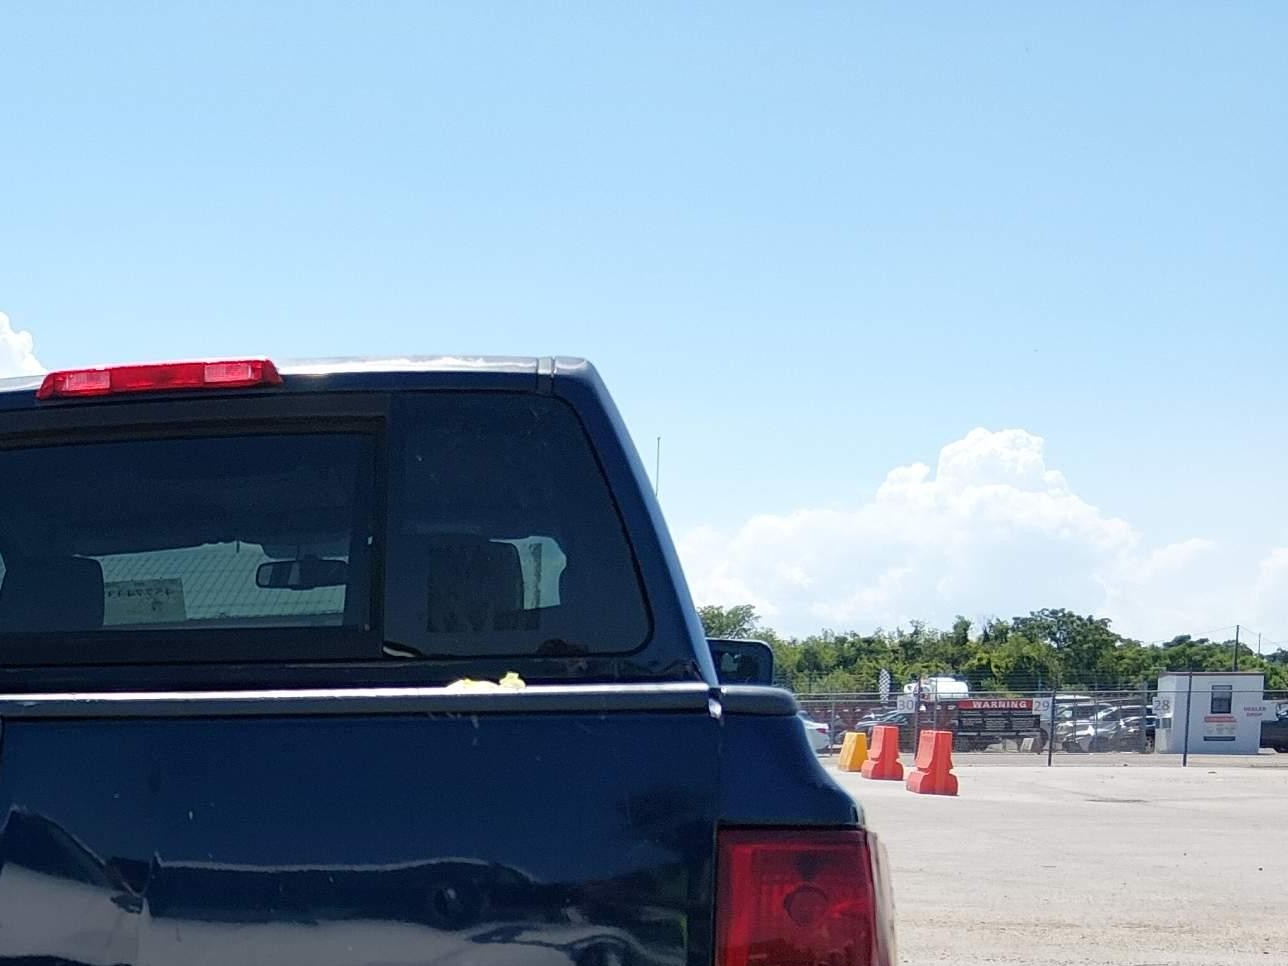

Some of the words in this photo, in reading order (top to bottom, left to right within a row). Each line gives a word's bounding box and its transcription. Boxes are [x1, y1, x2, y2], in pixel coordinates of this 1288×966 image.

[972, 701, 1028, 709] WARNING
[1034, 700, 1050, 712] 29
[1154, 700, 1170, 711] 28
